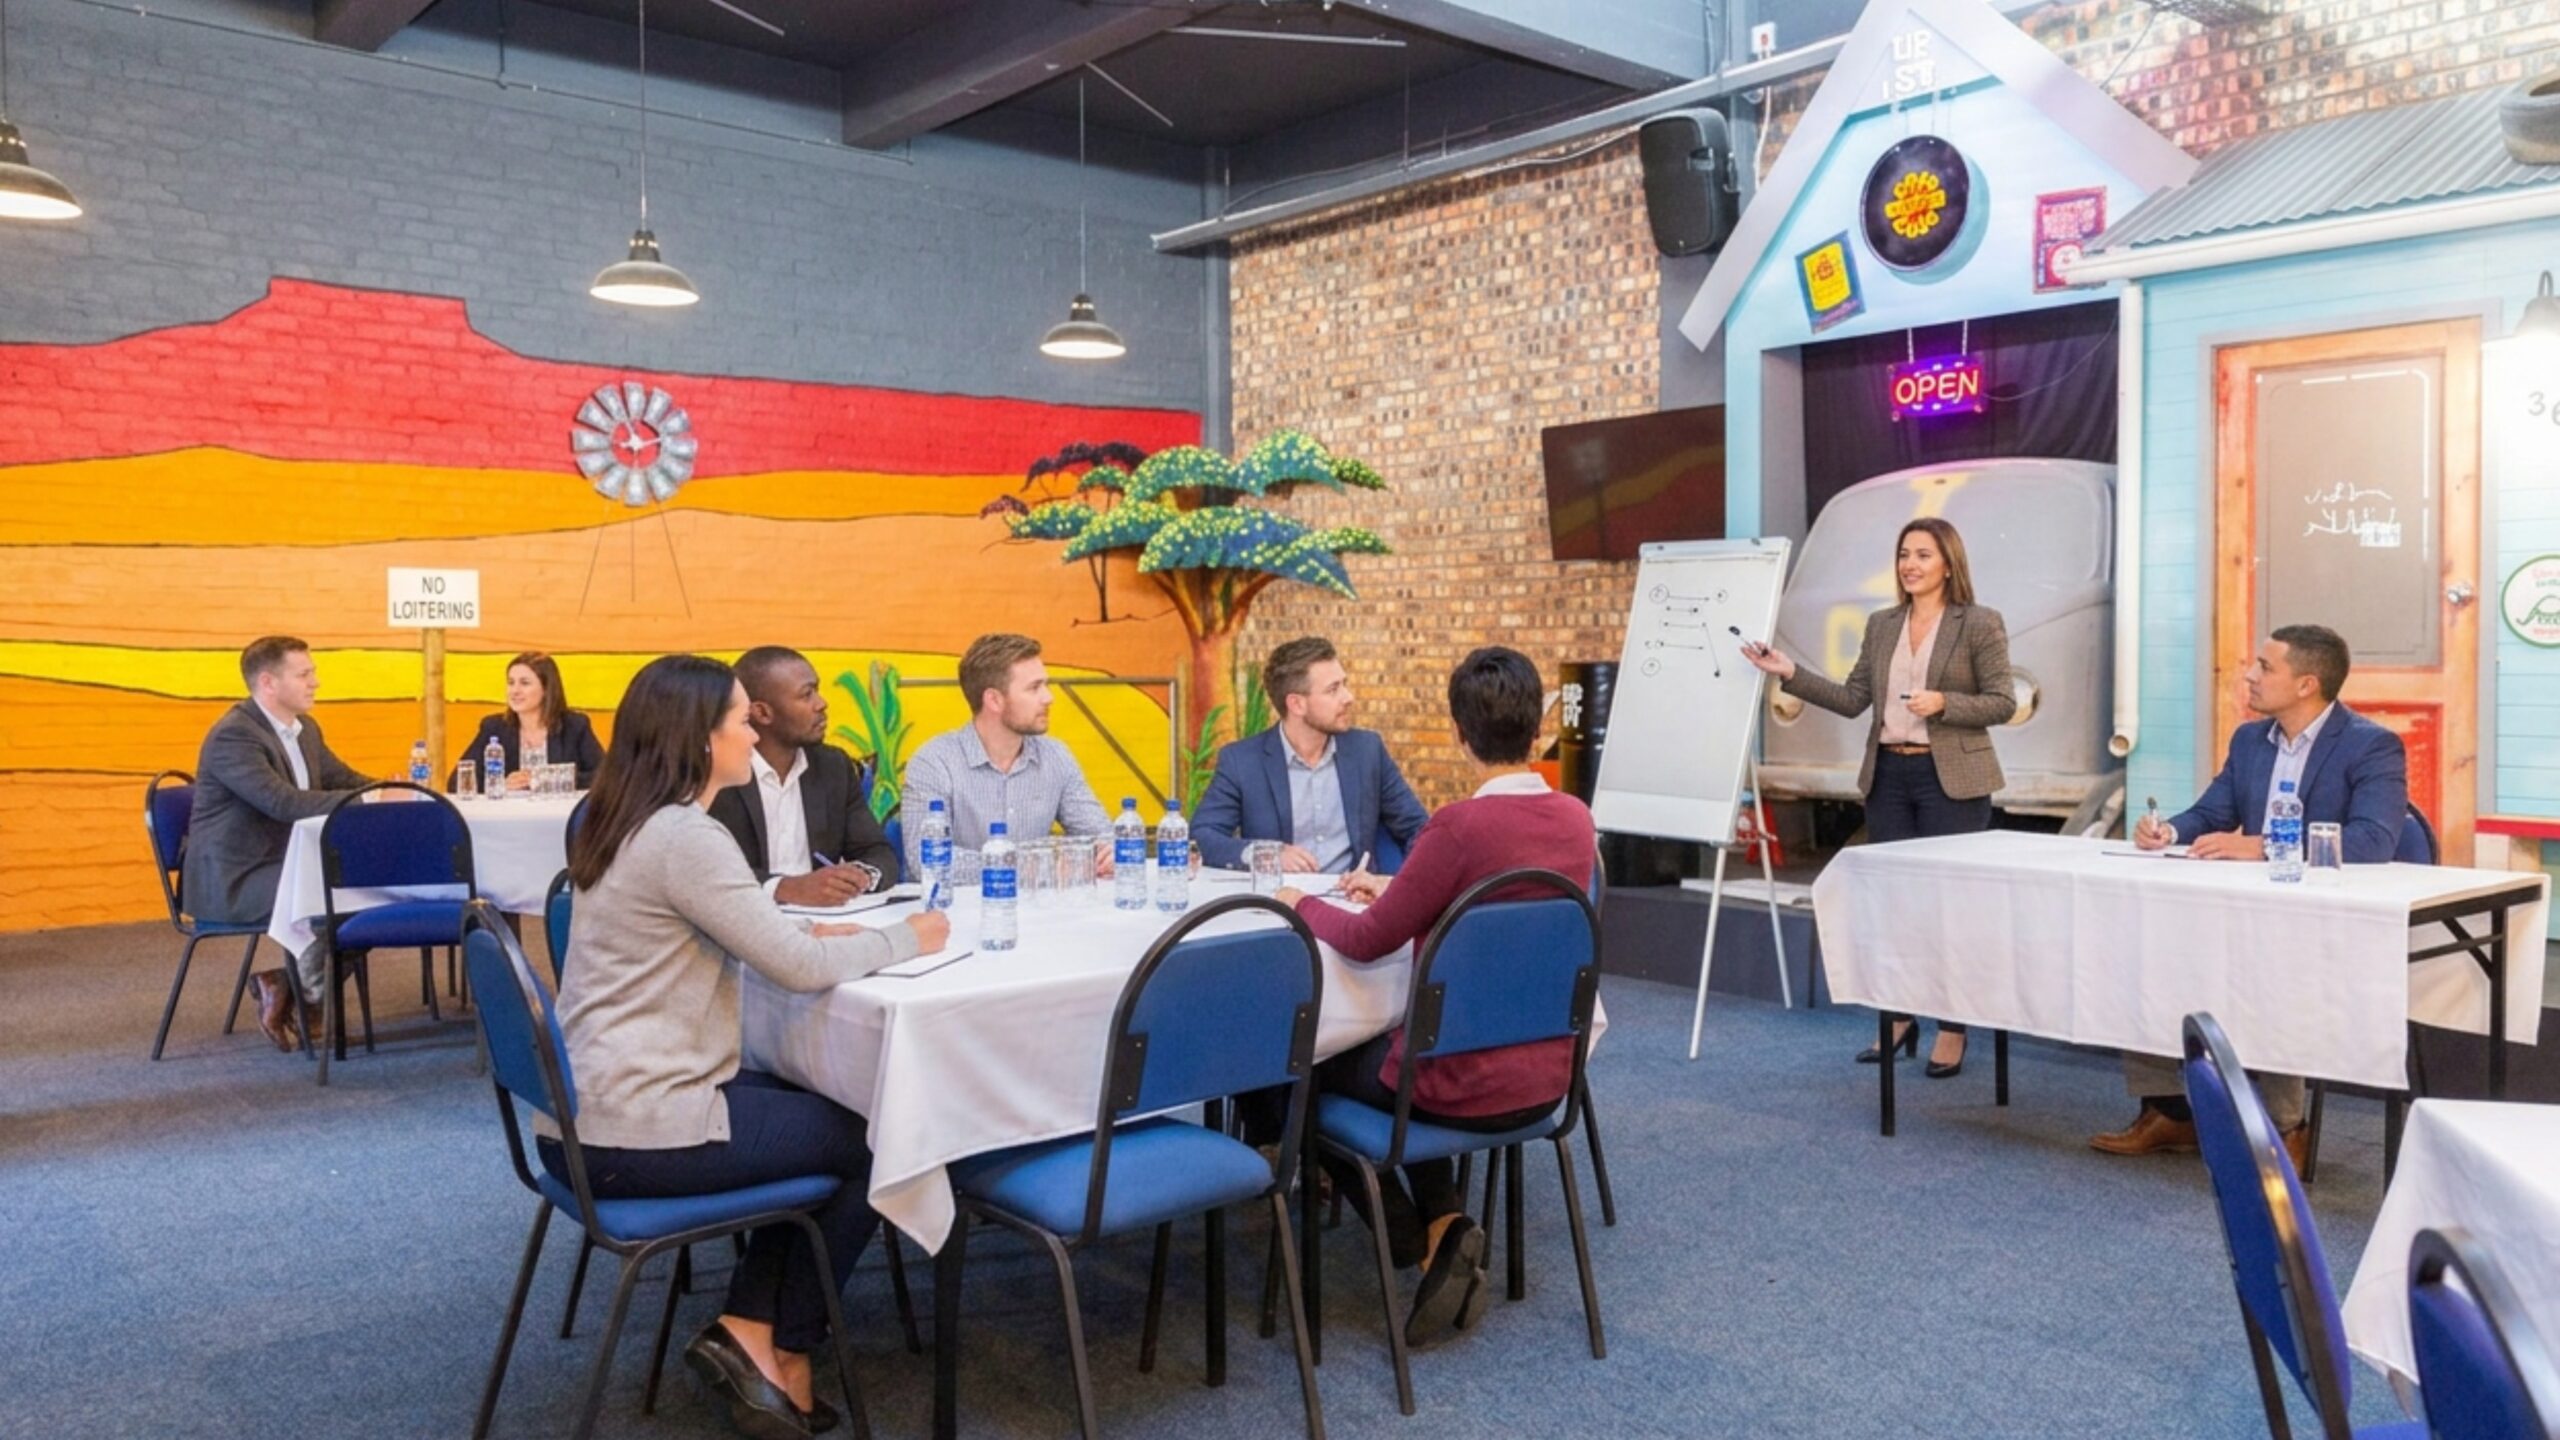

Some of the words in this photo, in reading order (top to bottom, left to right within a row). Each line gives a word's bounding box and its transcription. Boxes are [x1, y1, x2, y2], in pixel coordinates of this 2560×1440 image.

[1896, 370, 1979, 404] OPEN
[422, 577, 446, 595] NO
[393, 601, 475, 620] LOITERING
